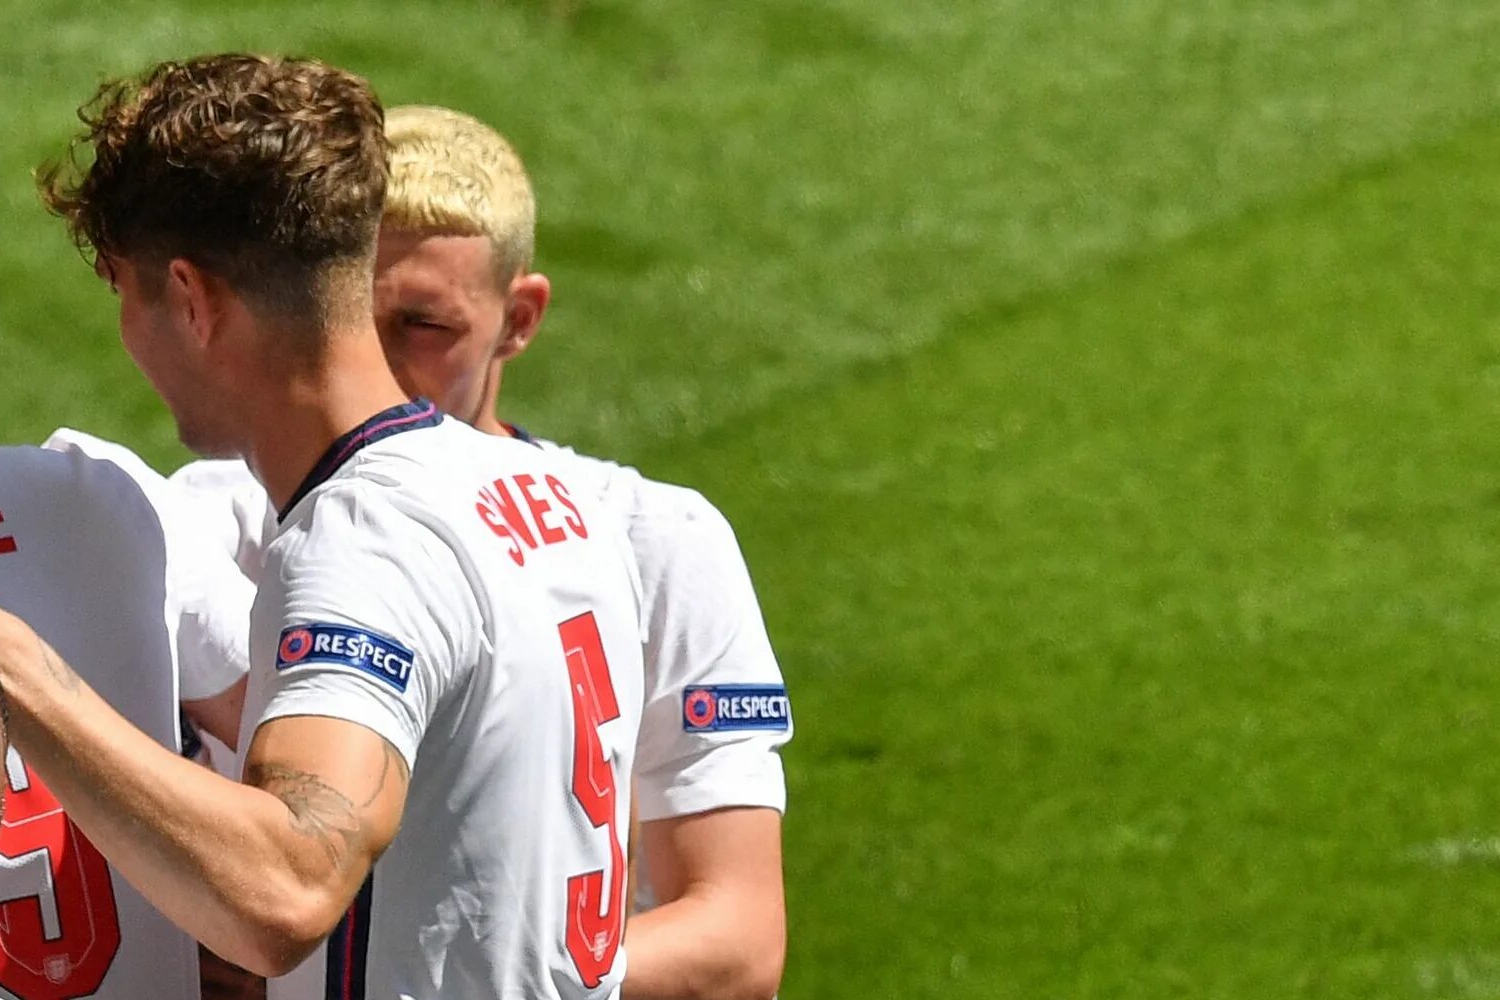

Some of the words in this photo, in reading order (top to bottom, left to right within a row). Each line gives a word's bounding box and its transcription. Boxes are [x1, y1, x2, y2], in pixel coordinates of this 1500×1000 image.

[314, 632, 412, 680] RESPECT
[718, 695, 788, 719] RESPECT
[557, 610, 626, 989] 5
